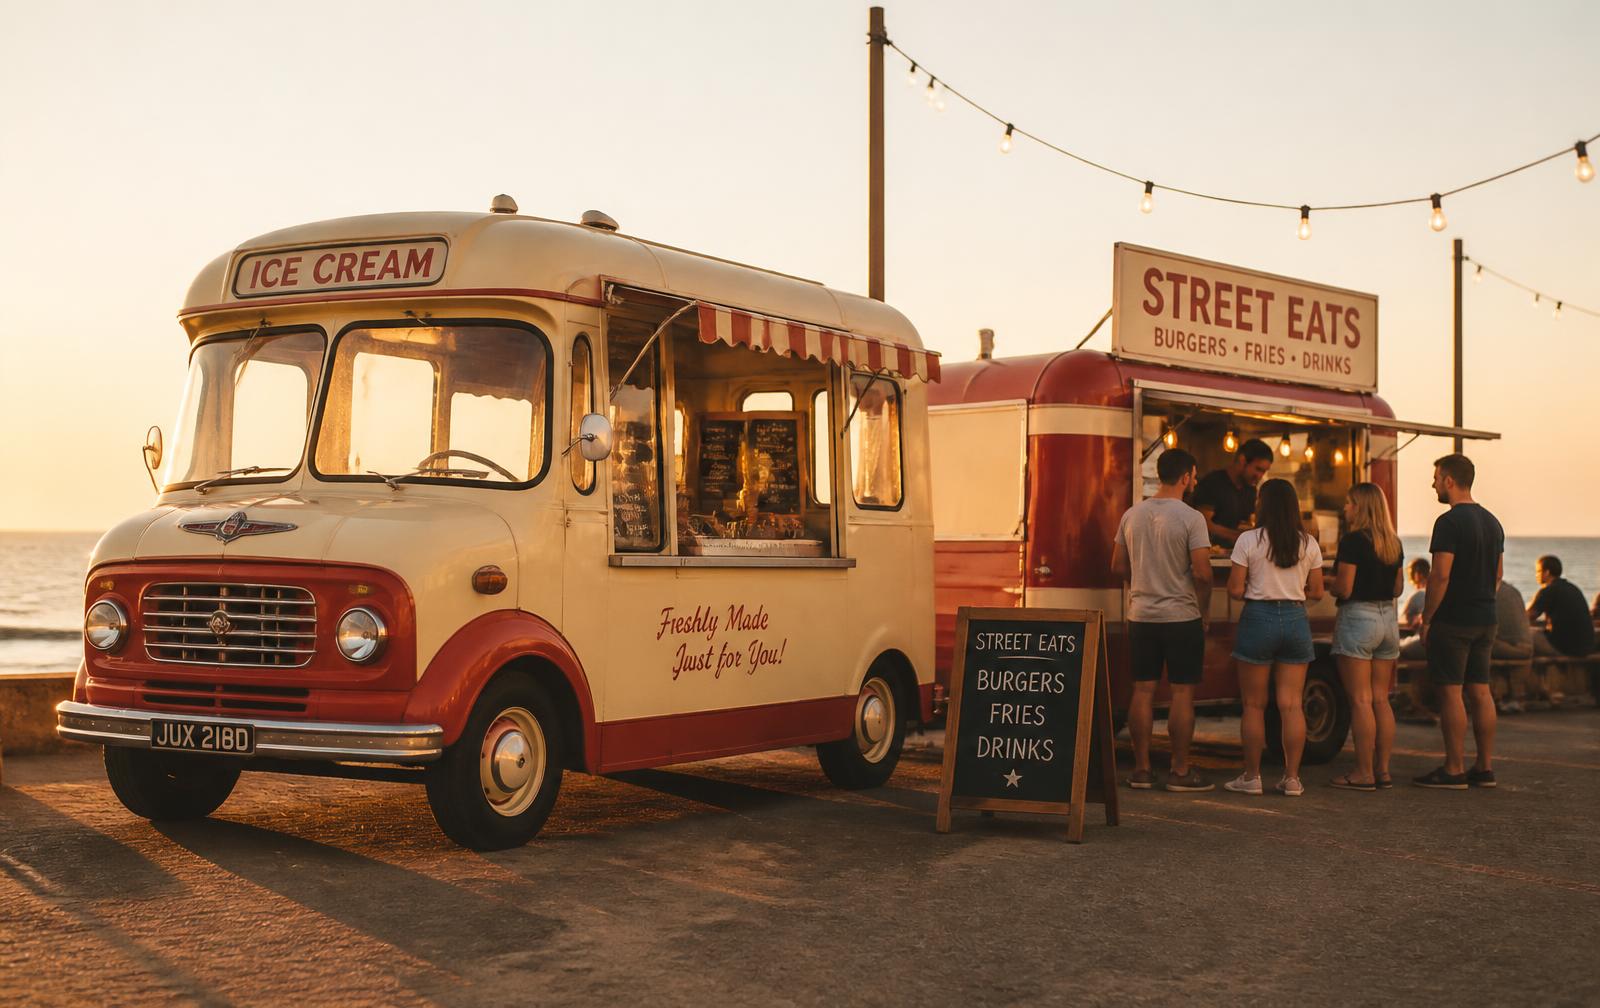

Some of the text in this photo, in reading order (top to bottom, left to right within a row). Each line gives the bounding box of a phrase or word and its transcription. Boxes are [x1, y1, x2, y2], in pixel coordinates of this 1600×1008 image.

[250, 248, 434, 289] ICE CREAM
[1143, 267, 1361, 349] STREET EATS
[1154, 327, 1351, 375] BURGERS FRIES DRINKS
[656, 604, 769, 641] Freshly Made
[976, 632, 1076, 653] STREET EATS
[672, 638, 787, 681] Just for You!
[977, 669, 1065, 694] BURGERS
[990, 703, 1046, 726] FRIES
[157, 723, 248, 751] JUX 218D
[977, 735, 1054, 761] DRINKS
